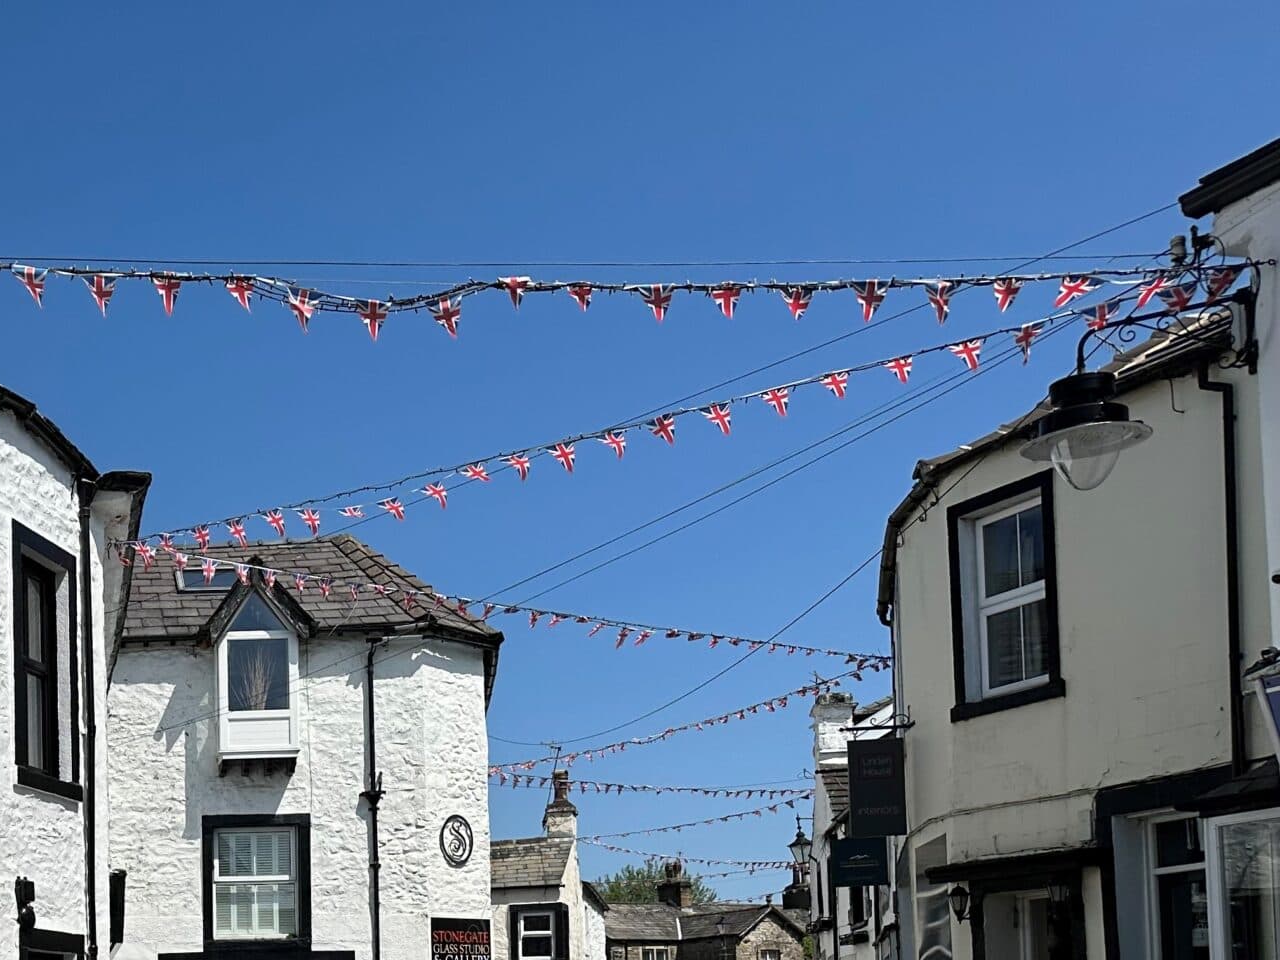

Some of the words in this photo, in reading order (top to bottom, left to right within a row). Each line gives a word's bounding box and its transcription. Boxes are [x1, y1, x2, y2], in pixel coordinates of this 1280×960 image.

[432, 930, 489, 943] STONEGATE
[433, 943, 458, 954] GLASS
[459, 944, 490, 955] STUDIO
